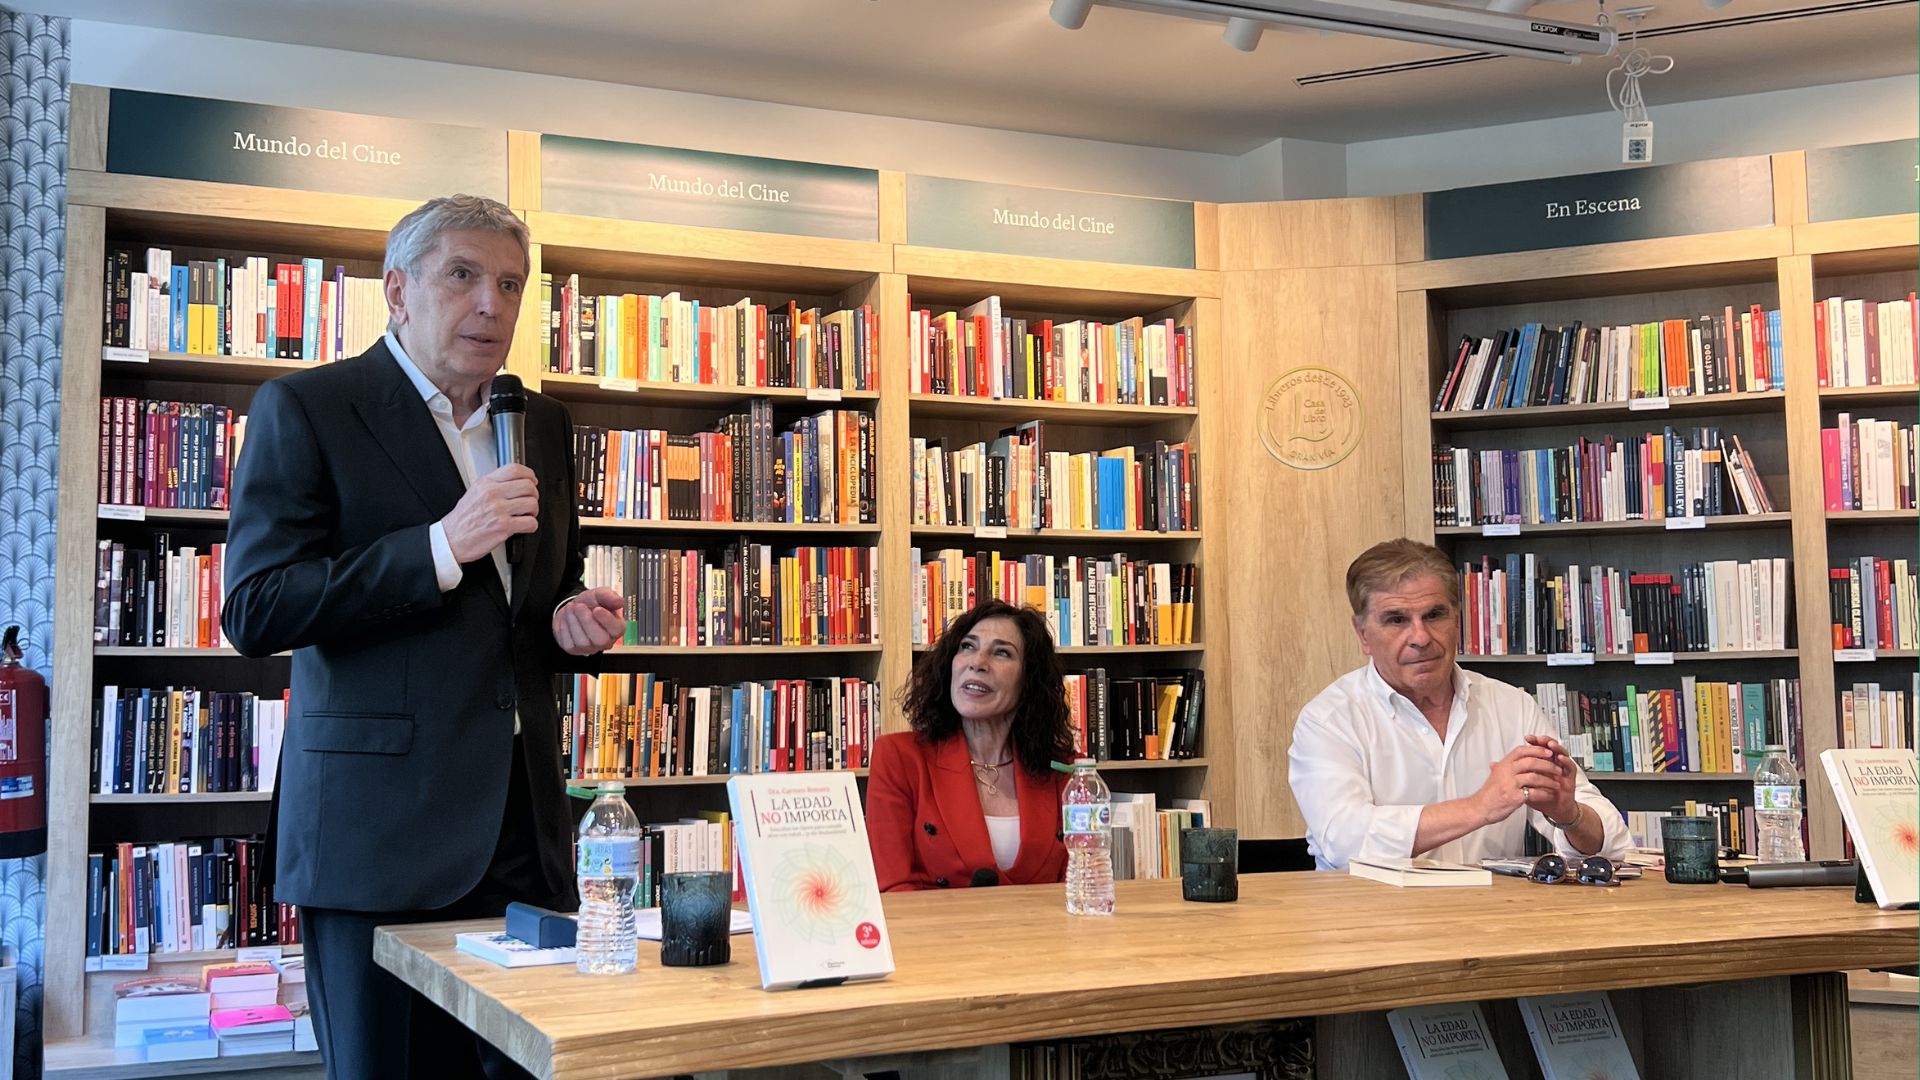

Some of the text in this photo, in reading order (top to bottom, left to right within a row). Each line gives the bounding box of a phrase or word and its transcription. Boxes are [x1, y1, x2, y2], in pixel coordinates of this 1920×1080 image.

[233, 131, 402, 166] Mundo del Cine
[648, 173, 790, 204] Mundo del Cine
[1545, 195, 1642, 219] En Escena
[993, 208, 1115, 235] Mundo del Cine
[1264, 375, 1303, 411] Libreros
[1304, 400, 1325, 408] Casa
[734, 438, 740, 446] DE
[746, 438, 751, 446] DE
[850, 437, 856, 446] LA
[1675, 465, 1684, 510] DIAGUILEV
[1088, 567, 1097, 635] ALFRED HITCHCOCK
[1858, 766, 1903, 775] LA EDAD
[1854, 776, 1916, 786] NO IMPORTA
[772, 796, 832, 810] LA EDAD
[761, 809, 848, 824] NO IMPORTA
[1555, 1008, 1596, 1022] LA EDAD
[1425, 1020, 1467, 1034] LA EDAD
[1550, 1018, 1609, 1033] NO IMPORTA
[1421, 1030, 1481, 1047] NO IMPORTA
